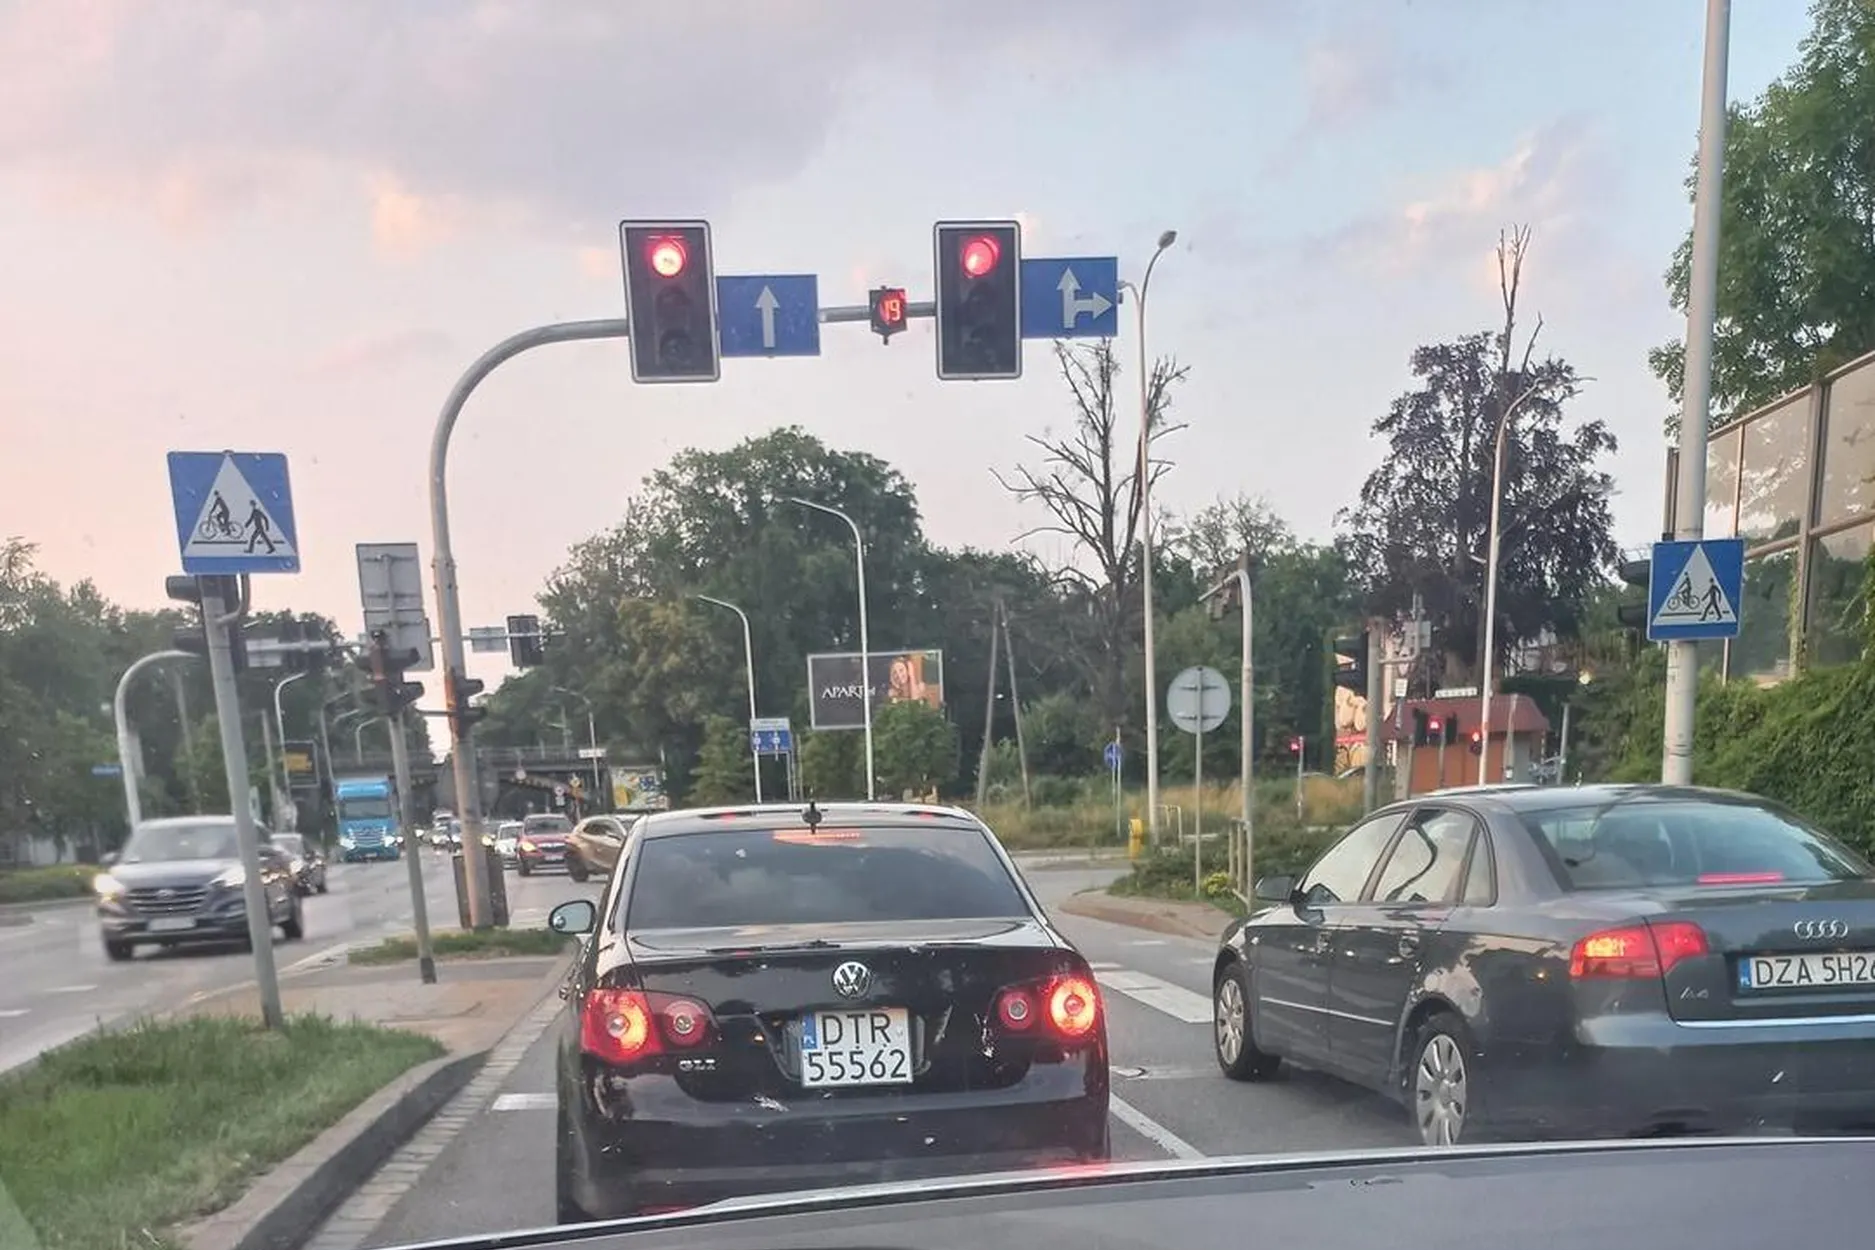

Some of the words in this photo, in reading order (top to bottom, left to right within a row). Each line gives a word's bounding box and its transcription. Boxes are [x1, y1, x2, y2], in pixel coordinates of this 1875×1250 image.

[884, 299, 900, 321] 19
[1755, 957, 1812, 986] DZA
[821, 1012, 891, 1045] DTR
[808, 1049, 907, 1082] 55562
